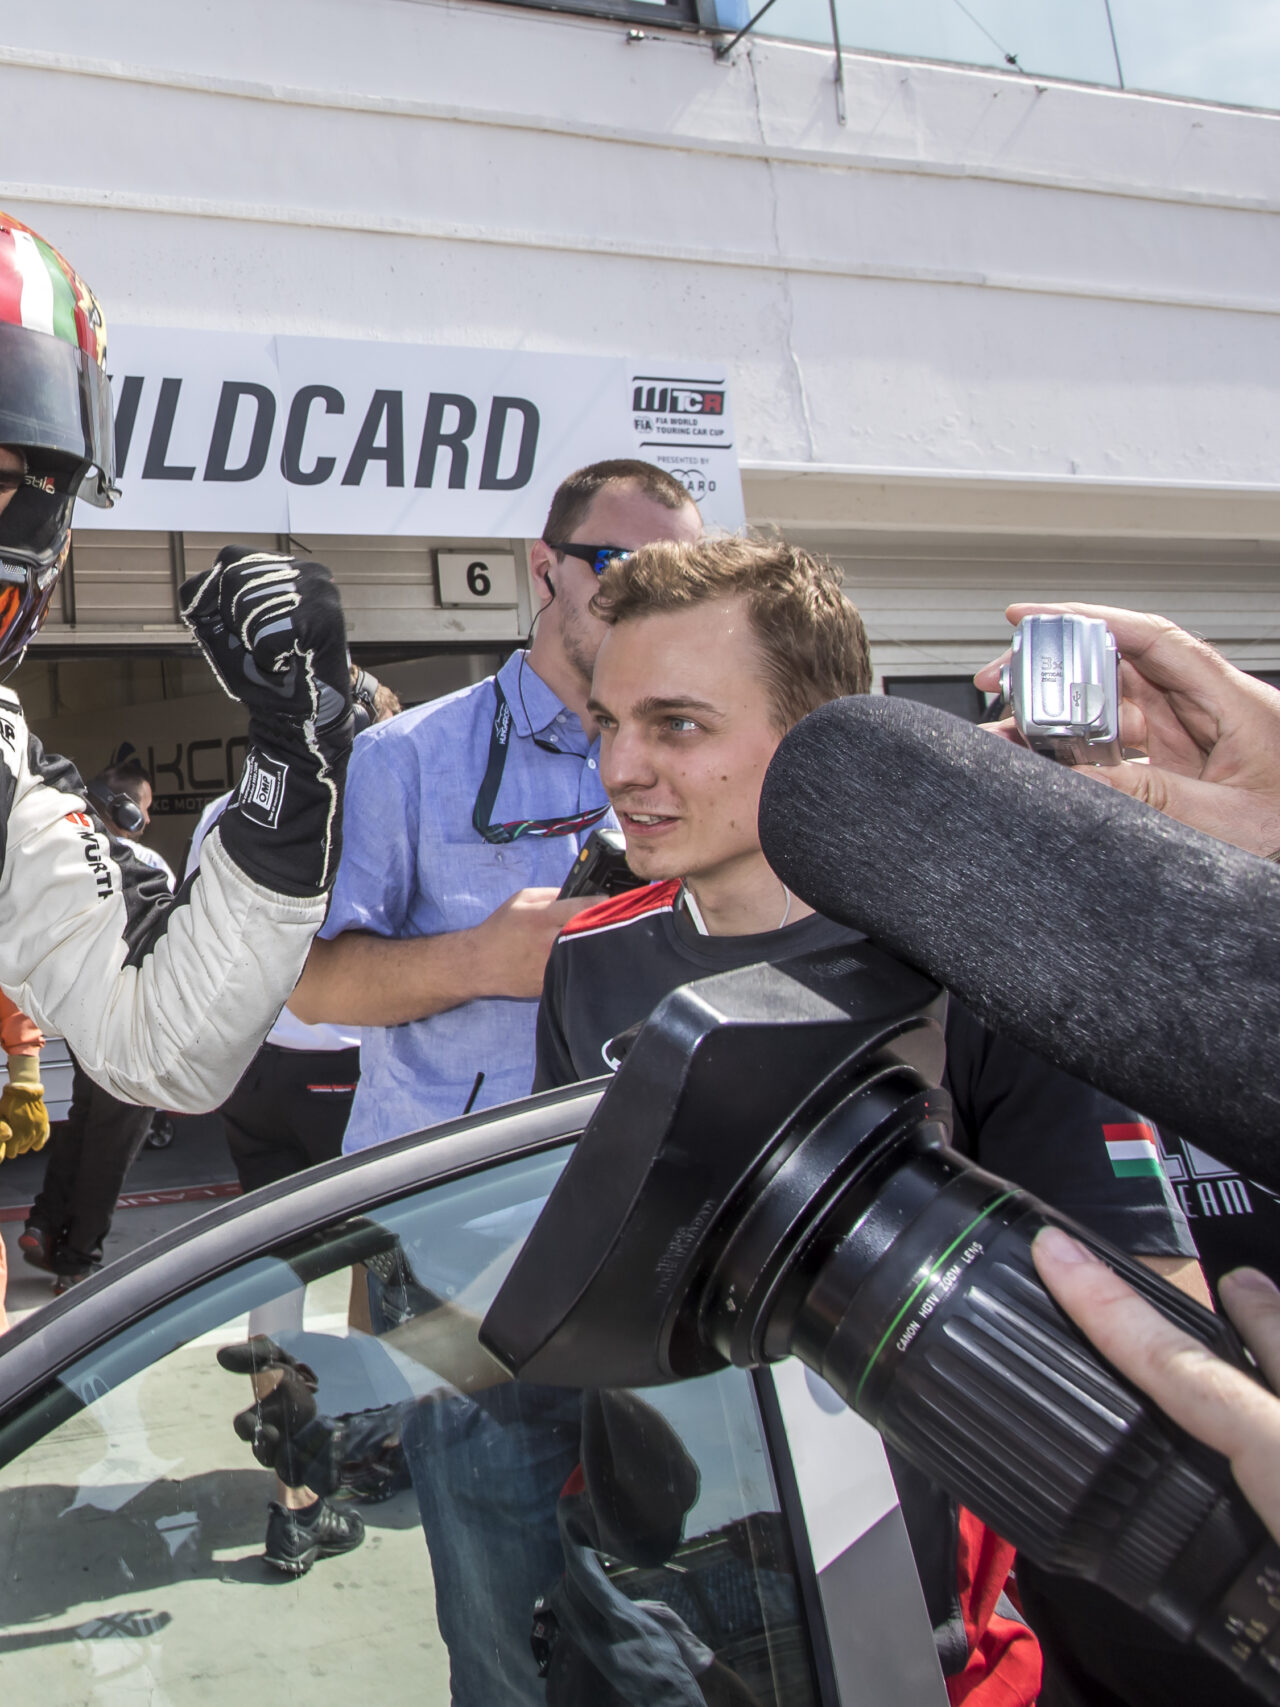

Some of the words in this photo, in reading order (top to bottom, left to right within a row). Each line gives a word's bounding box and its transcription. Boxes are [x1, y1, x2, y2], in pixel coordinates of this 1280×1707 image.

[632, 386, 725, 416] WTCR
[107, 374, 541, 492] ILDCARD
[656, 417, 668, 425] FIA
[670, 418, 698, 426] WORLD
[656, 426, 690, 435] TOURING
[693, 428, 707, 436] CAR
[710, 429, 724, 437] CUP
[657, 456, 698, 465] PRESENTED
[681, 480, 716, 492] ARO
[467, 561, 491, 597] 6
[258, 775, 271, 803] OMP
[1176, 1179, 1254, 1218] EAM
[896, 1320, 921, 1352] CANON
[918, 1293, 940, 1319] HDTV
[940, 1264, 962, 1292] ZOOM
[961, 1241, 984, 1264] LENS
